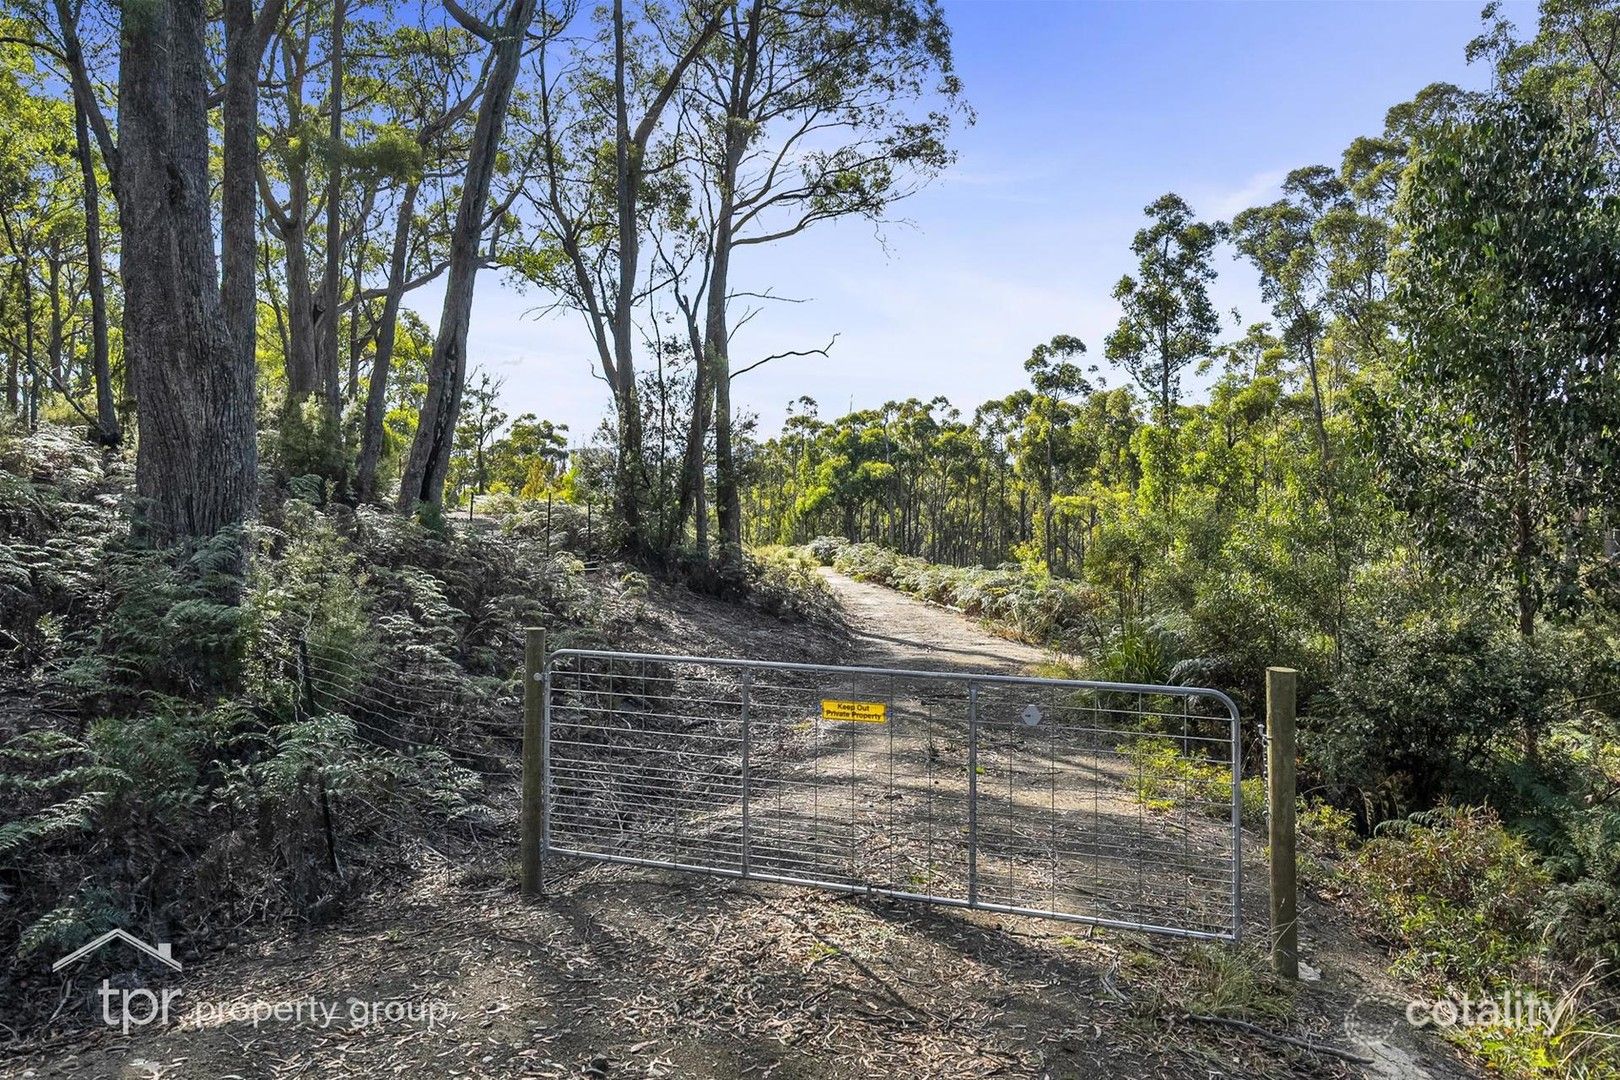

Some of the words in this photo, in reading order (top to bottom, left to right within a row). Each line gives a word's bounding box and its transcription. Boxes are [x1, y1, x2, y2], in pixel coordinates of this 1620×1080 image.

[837, 703, 855, 711] Keep
[857, 704, 870, 712] Out
[826, 710, 849, 718] Private
[852, 711, 881, 720] Property
